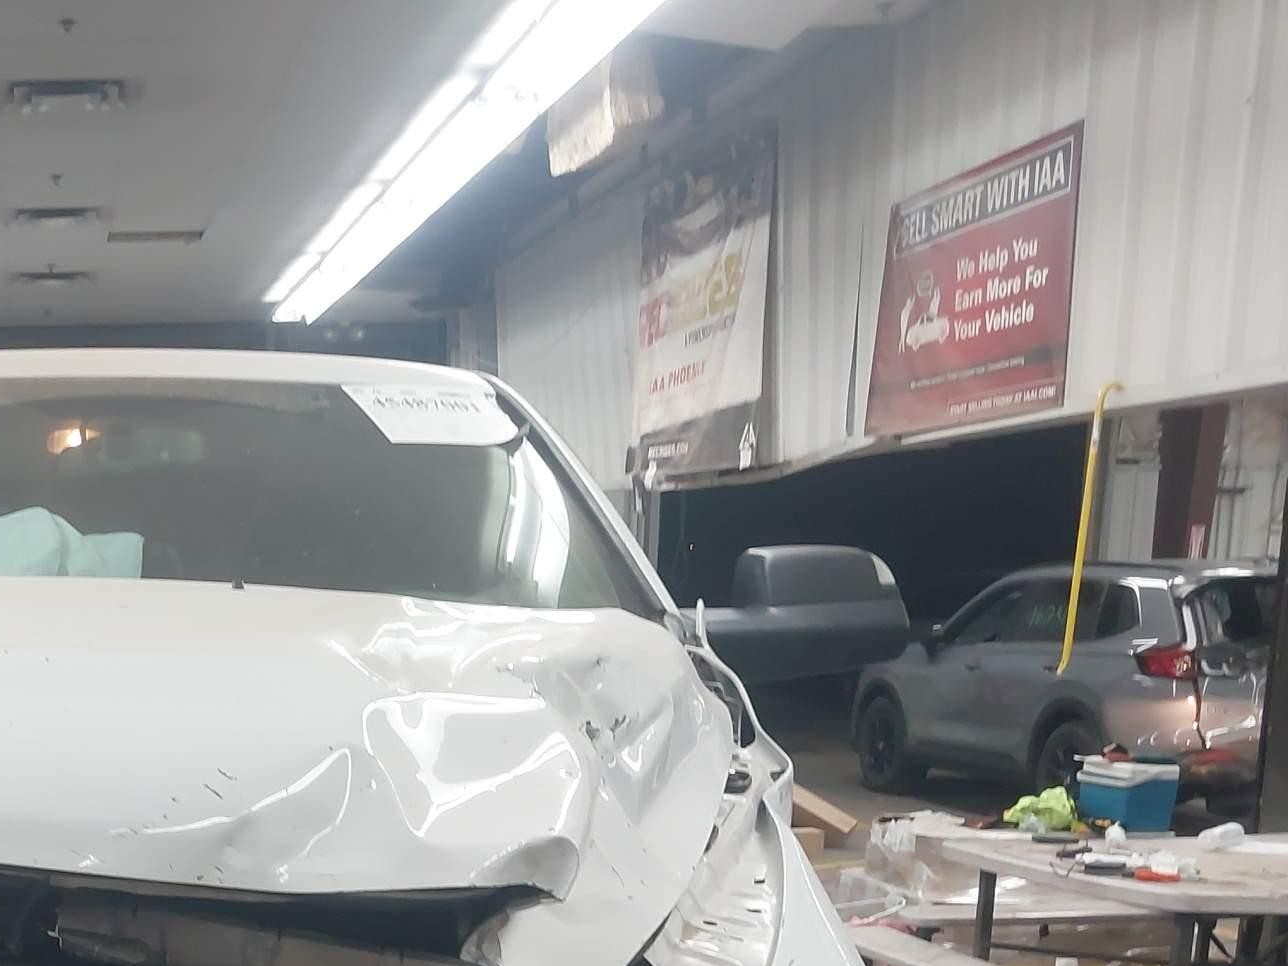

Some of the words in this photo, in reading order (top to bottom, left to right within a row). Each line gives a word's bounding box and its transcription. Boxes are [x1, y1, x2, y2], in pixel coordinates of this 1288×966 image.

[931, 185, 984, 236] SMART
[987, 164, 1030, 214] WITH
[1034, 150, 1065, 196] IAA
[956, 257, 975, 282] We
[979, 244, 1008, 274] Help
[1013, 236, 1038, 263] You
[955, 287, 982, 312] Earn
[986, 275, 1021, 302] More
[1025, 265, 1048, 292] For
[954, 318, 981, 342] Your
[985, 299, 1034, 333] Vehicle
